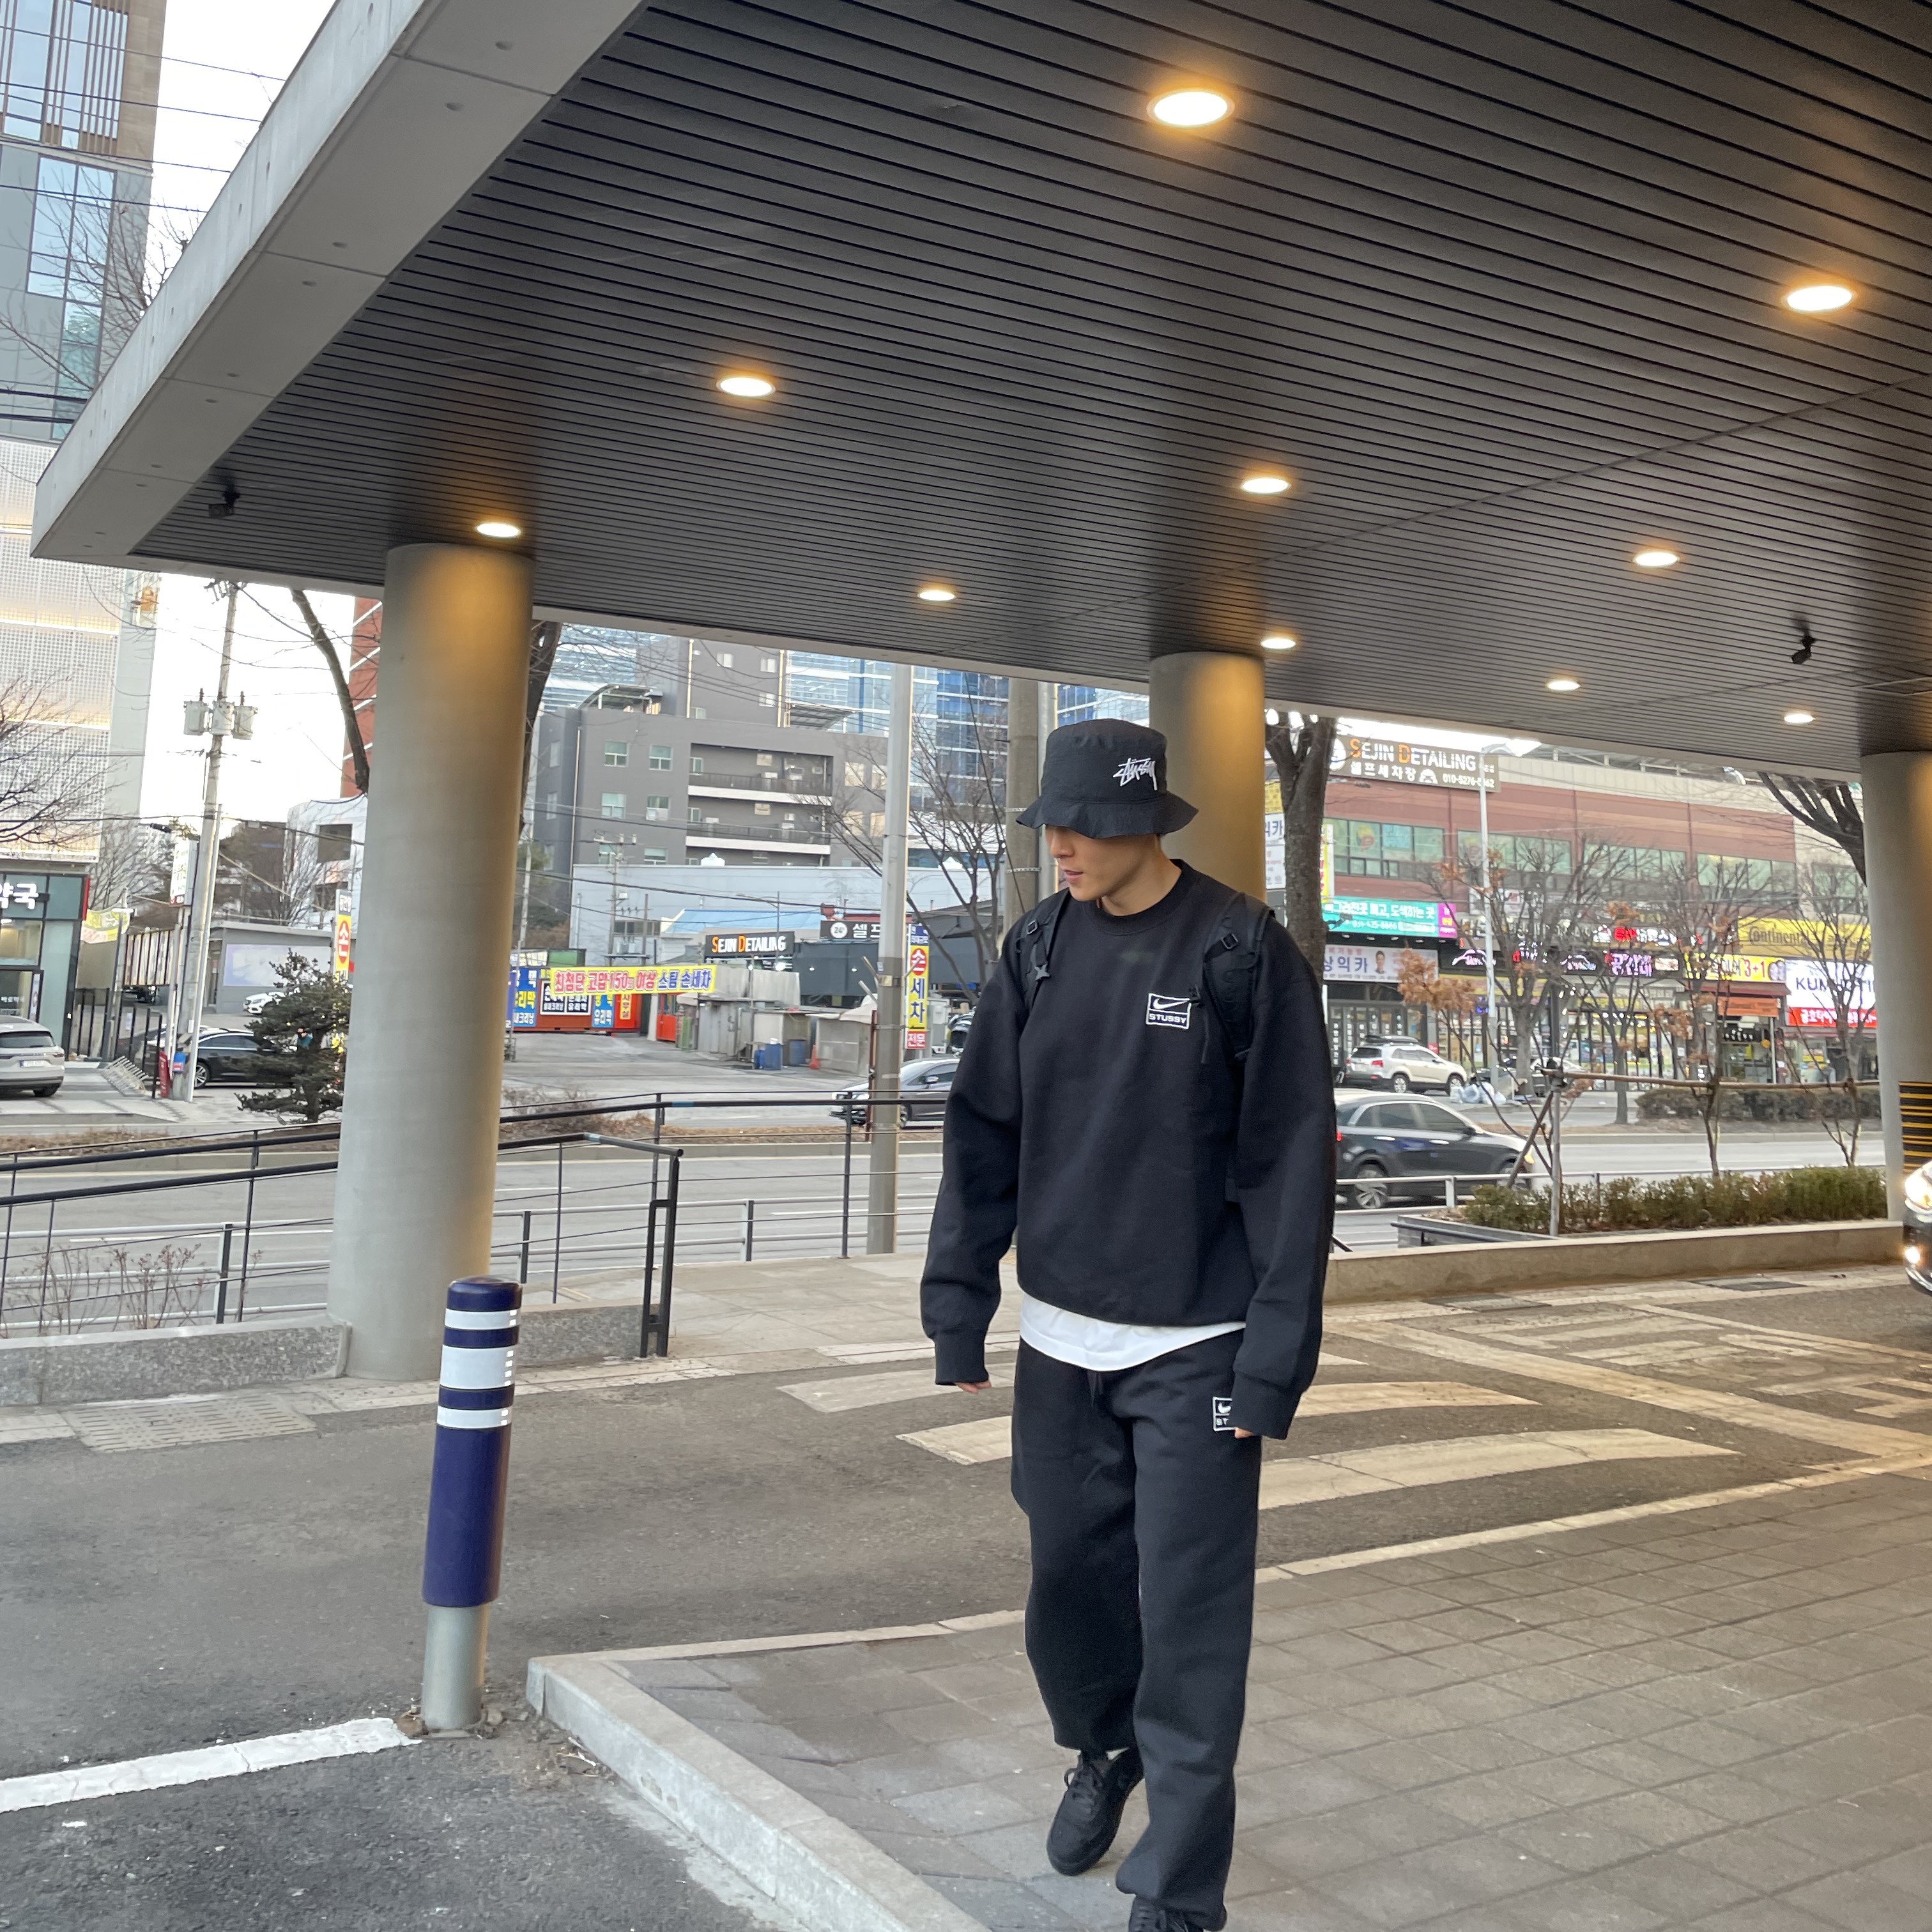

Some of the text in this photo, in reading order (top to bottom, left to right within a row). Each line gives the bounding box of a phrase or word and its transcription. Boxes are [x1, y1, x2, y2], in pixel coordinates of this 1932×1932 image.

[1349, 739, 1476, 772] SEJIN DETAILING
[711, 935, 786, 953] SEJIN DETAILING
[1744, 958, 1766, 978] 3+1
[1149, 1013, 1186, 1024] STUSSY
